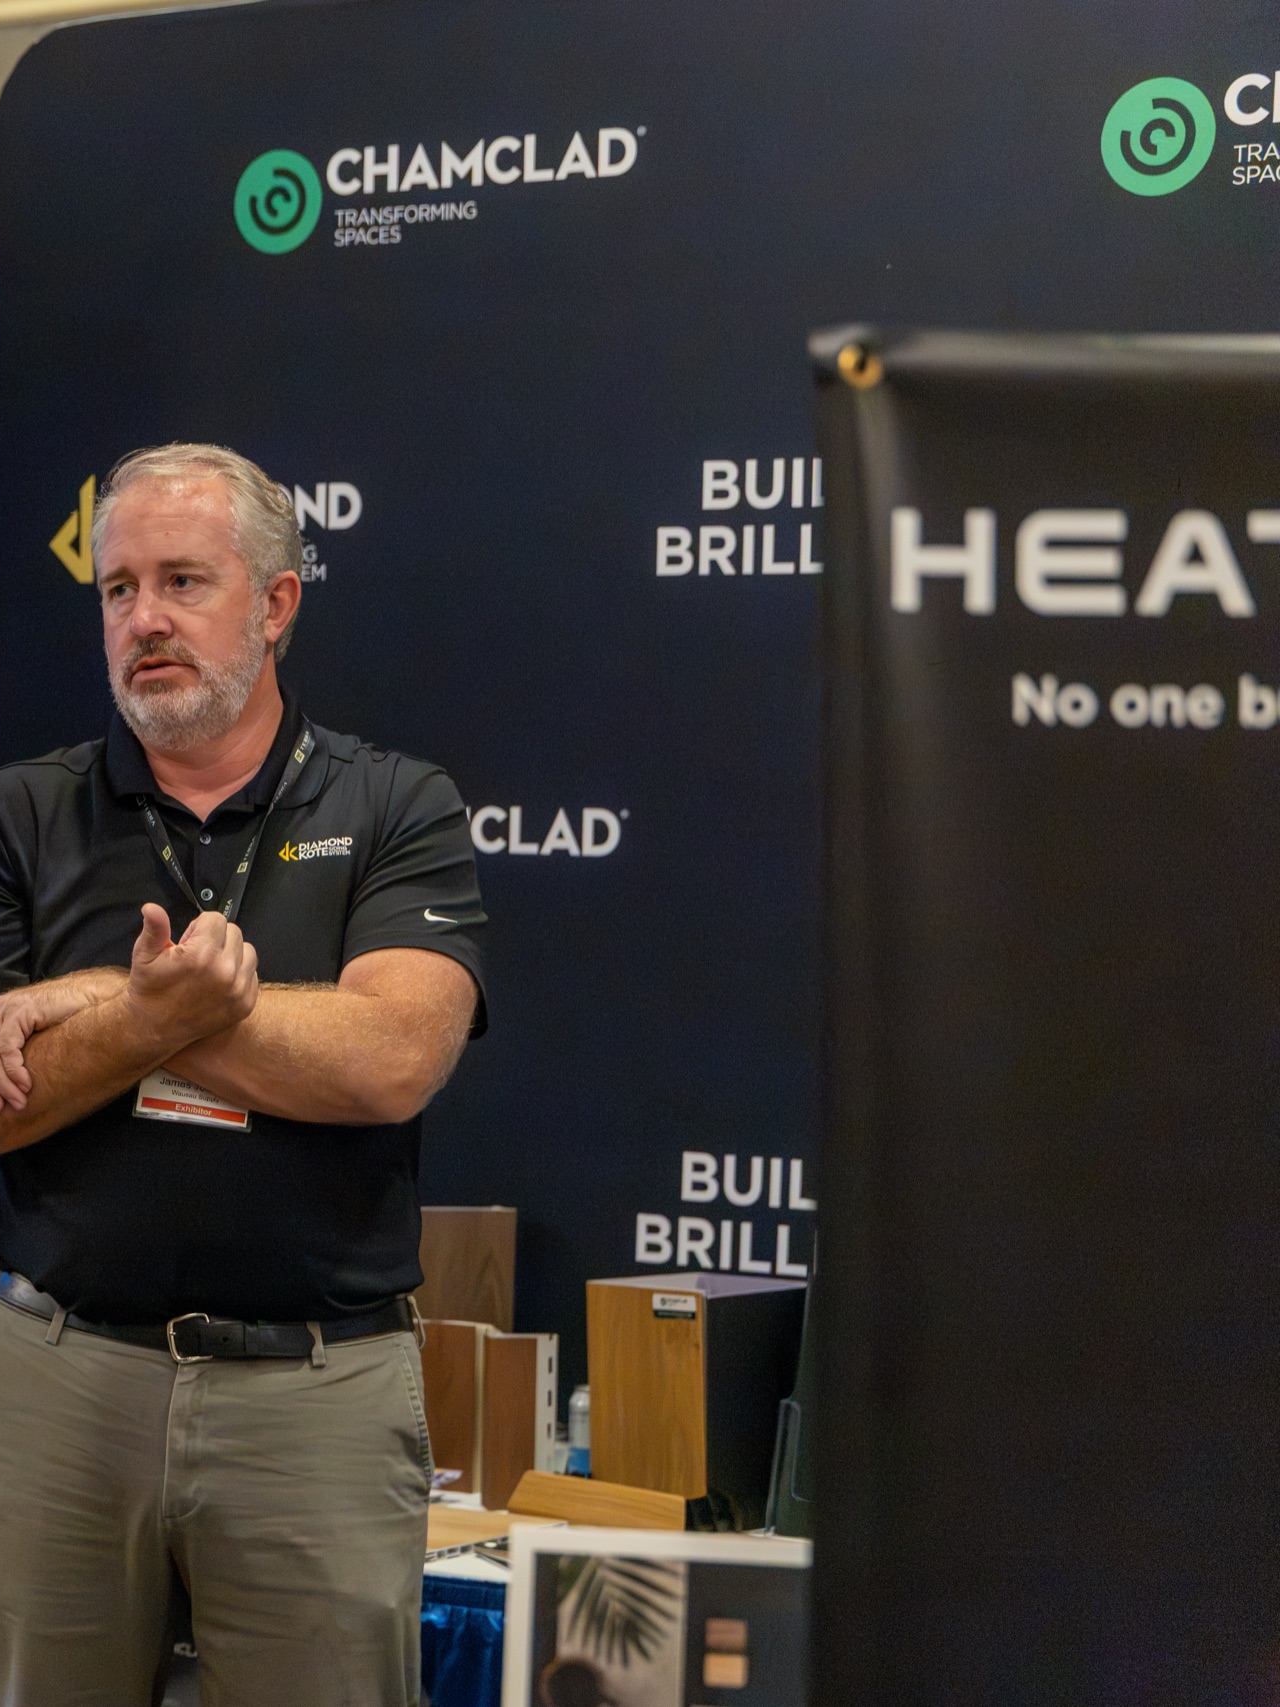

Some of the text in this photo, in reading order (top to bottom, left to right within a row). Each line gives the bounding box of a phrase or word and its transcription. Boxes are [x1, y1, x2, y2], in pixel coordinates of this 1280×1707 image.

[1224, 70, 1280, 126] C
[326, 126, 639, 197] CHAMCLAD
[1232, 164, 1280, 186] SPA
[334, 200, 478, 229] TRANSFORMING
[334, 225, 402, 248] SPACES
[701, 457, 824, 511] BUIL
[655, 522, 824, 578] BRILL
[1011, 671, 1280, 731] No one b
[298, 836, 353, 852] DIAMOND
[466, 804, 622, 858] CLAD
[298, 847, 329, 861] KOTE
[159, 1076, 192, 1089] James
[171, 1089, 198, 1099] Wausau
[175, 1103, 213, 1117] Exhibitor
[680, 1150, 818, 1212] BUIL
[634, 1211, 812, 1278] BRILL
